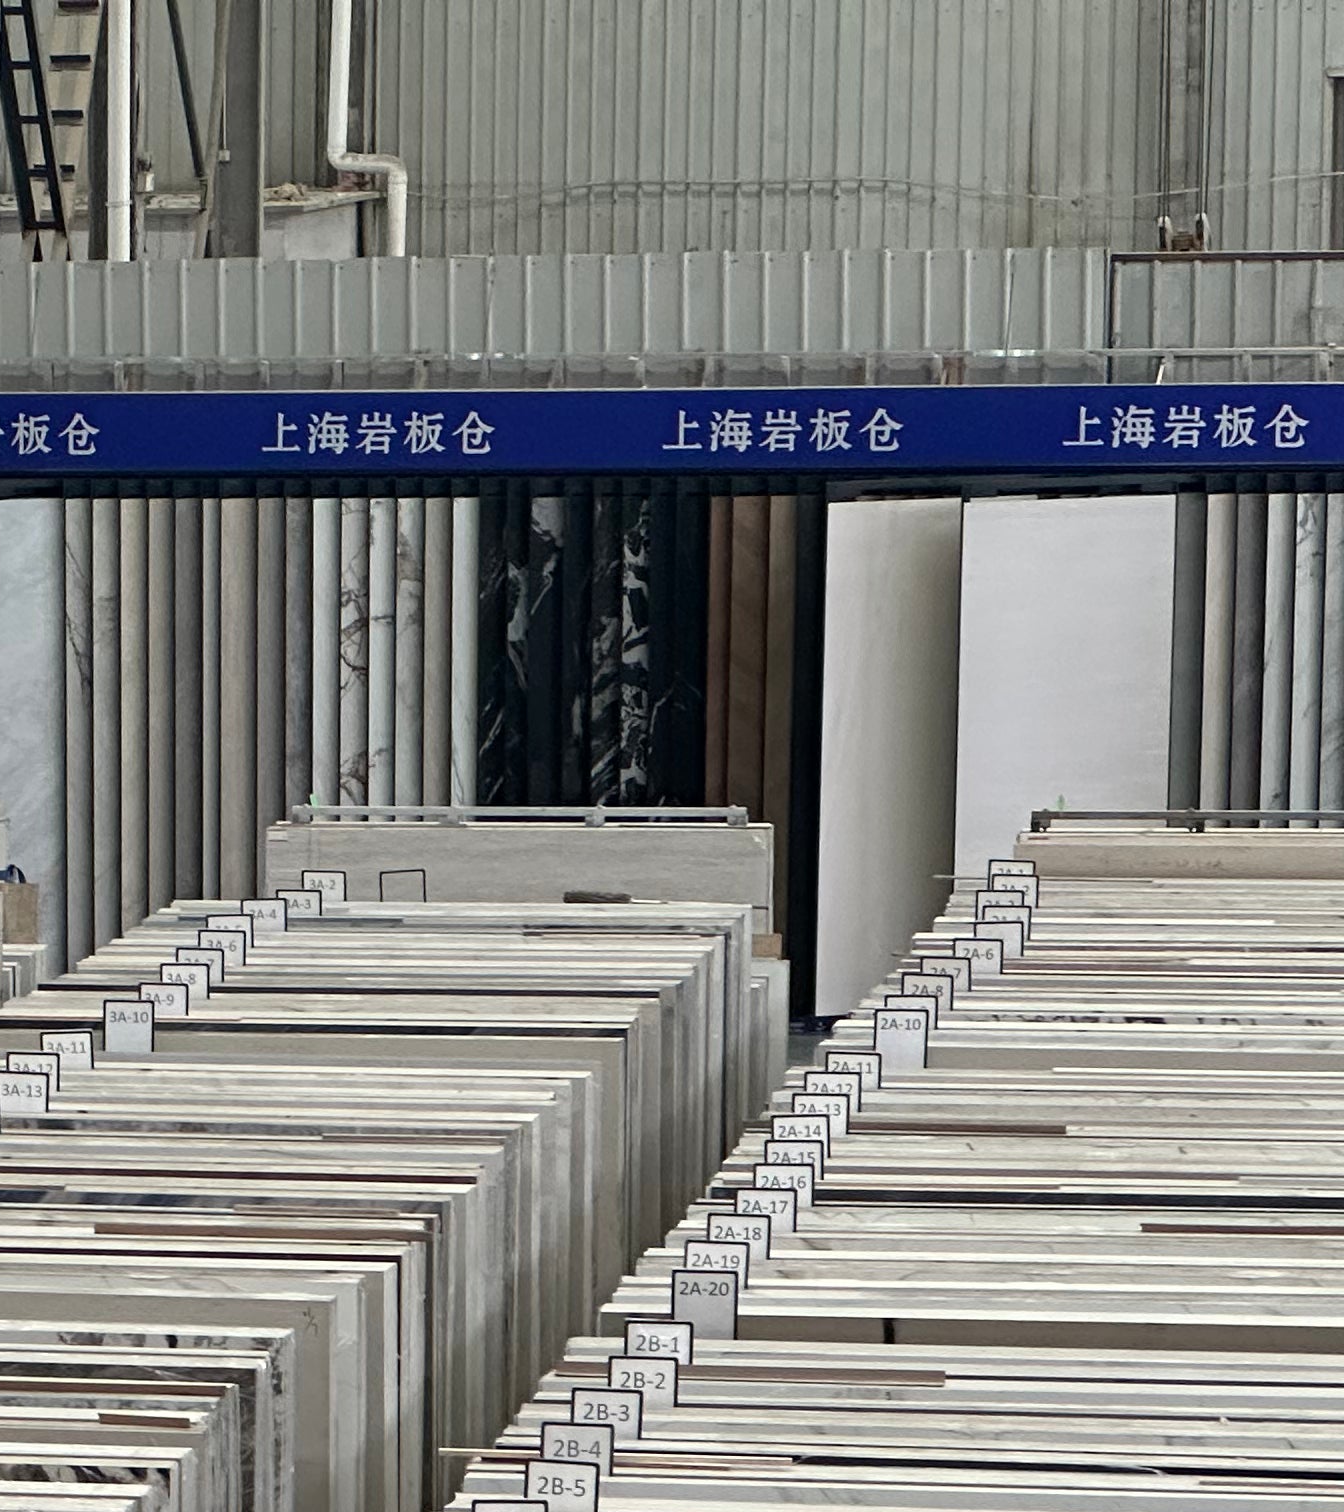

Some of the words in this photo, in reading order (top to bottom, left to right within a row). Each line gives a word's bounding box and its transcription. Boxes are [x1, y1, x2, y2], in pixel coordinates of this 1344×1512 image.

[262, 411, 495, 454] 上海岩板仓
[662, 408, 903, 452] 上海岩板仓
[1063, 404, 1309, 448] 上海岩板仓
[110, 1011, 148, 1023] 3A-10
[881, 1018, 921, 1030] 2A-10
[3, 1084, 42, 1097] 3A-13
[779, 1125, 821, 1138] 2A-14
[760, 1176, 806, 1189] 2A-16
[742, 1199, 788, 1213] 2A-17
[715, 1226, 761, 1240] 2A-18
[692, 1254, 740, 1269] 2A-19
[680, 1282, 729, 1296] 2A-20
[635, 1335, 679, 1353] 2B-1
[621, 1372, 665, 1389] 2B-2
[584, 1403, 629, 1421] 2B-3
[554, 1440, 601, 1458] 2B-4
[538, 1476, 585, 1497] 2B-5
